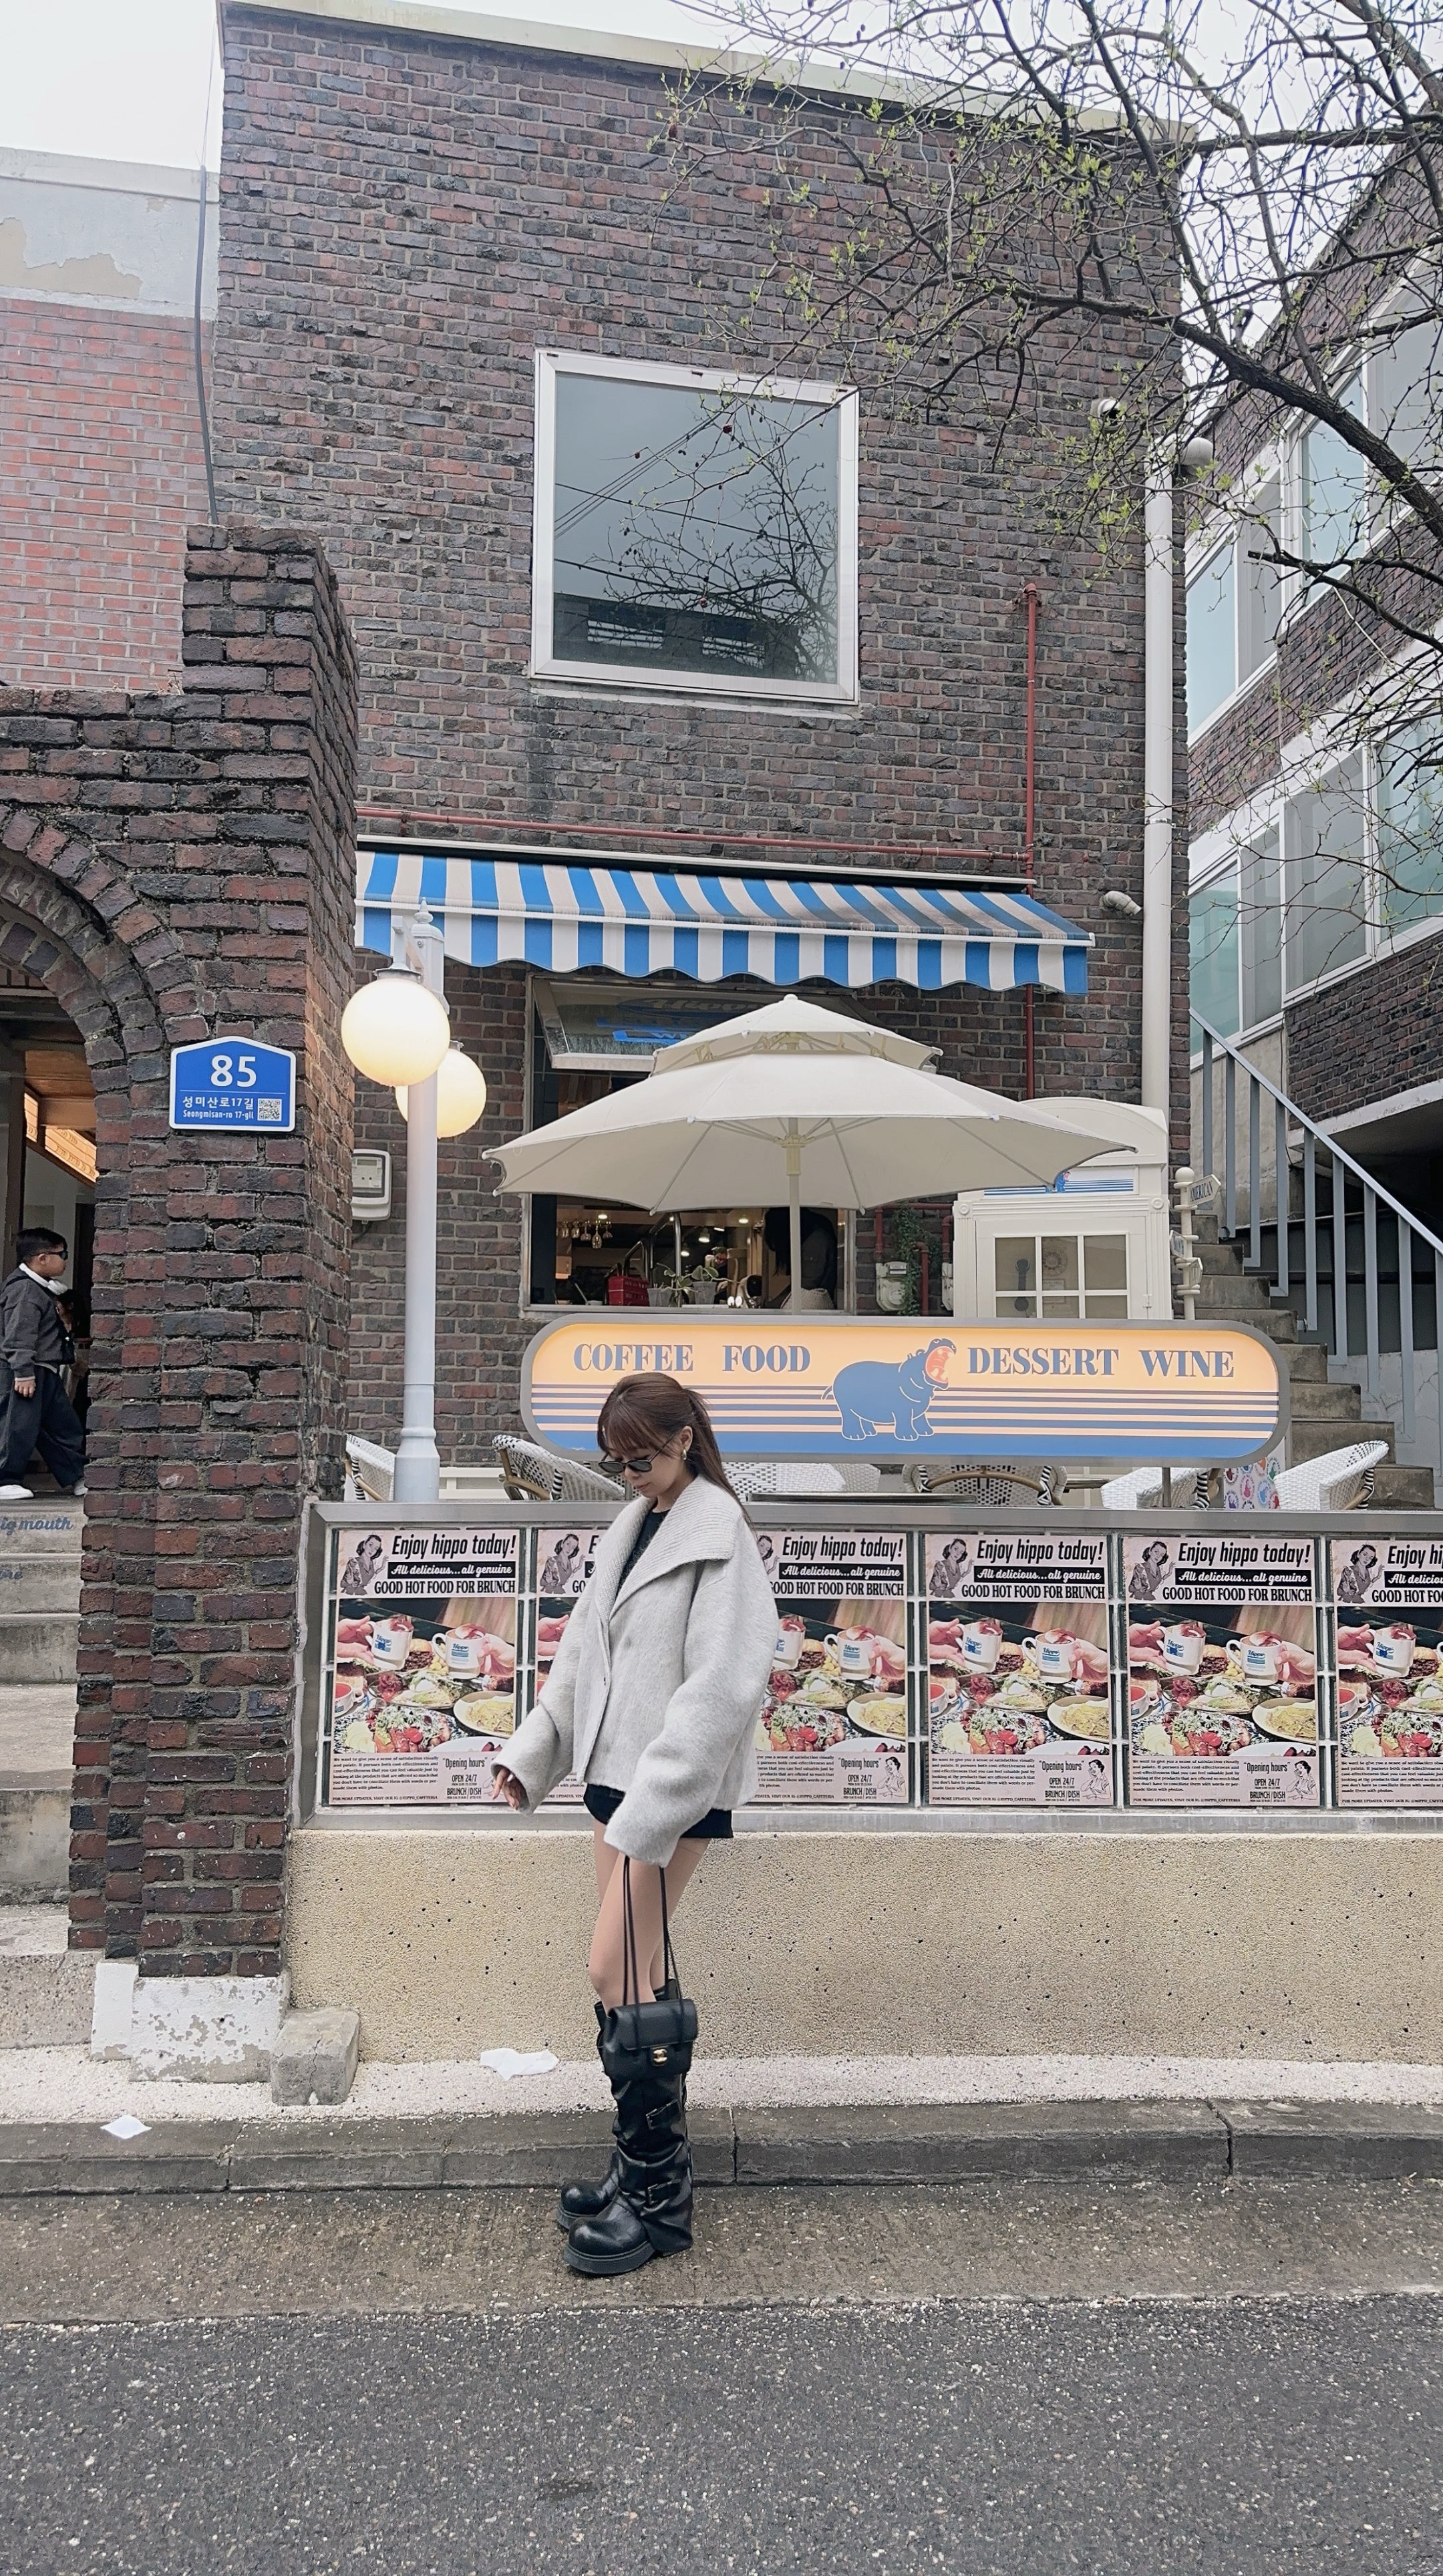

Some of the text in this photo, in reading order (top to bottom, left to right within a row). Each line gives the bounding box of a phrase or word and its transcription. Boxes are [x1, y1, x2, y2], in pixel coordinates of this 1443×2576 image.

[210, 1055, 257, 1087] 85
[182, 1096, 254, 1110] 성미산로17길
[183, 1109, 254, 1120] Seongmisan-ro 17-gil
[1190, 1180, 1213, 1202] AMERICAN
[574, 1344, 1235, 1378] COFFEE FOOD DESSERT WINE
[19, 1517, 73, 1530] mouth
[391, 1533, 516, 1559] Enjoy hippo today!
[782, 1535, 904, 1562] Enjoy hippo today!
[976, 1539, 1104, 1565] Enjoy hippo today!
[1178, 1541, 1311, 1568] Enjoy hippo today!
[1388, 1544, 1426, 1569] Enjoy
[391, 1564, 408, 1576] All
[476, 1564, 513, 1578] genuine
[782, 1565, 798, 1576] All
[864, 1567, 901, 1580] genuine
[977, 1568, 994, 1579] All
[1063, 1570, 1102, 1584] genuine
[1178, 1571, 1196, 1582] All
[1269, 1573, 1309, 1586] genuine
[1388, 1574, 1407, 1584] All
[375, 1580, 516, 1595] GOOD HOT FOOD FOR BRUNCH
[796, 1582, 816, 1596] HOT
[818, 1582, 844, 1596] FOOD
[846, 1582, 865, 1596] FOR
[866, 1582, 905, 1596] BRUNCH
[961, 1584, 1105, 1600] GOOD HOT FOOD FOR BRUNCH
[1162, 1586, 1312, 1602] GOOD HOT FOOD FOR BRUNCH
[1372, 1590, 1443, 1603] GOOD HOT FO
[452, 1774, 478, 1783] OPEN 24/7
[847, 1774, 872, 1783] OPEN 24/7
[1049, 1777, 1075, 1785] OPEN 24/7
[1254, 1778, 1281, 1787] OPEN 24/7
